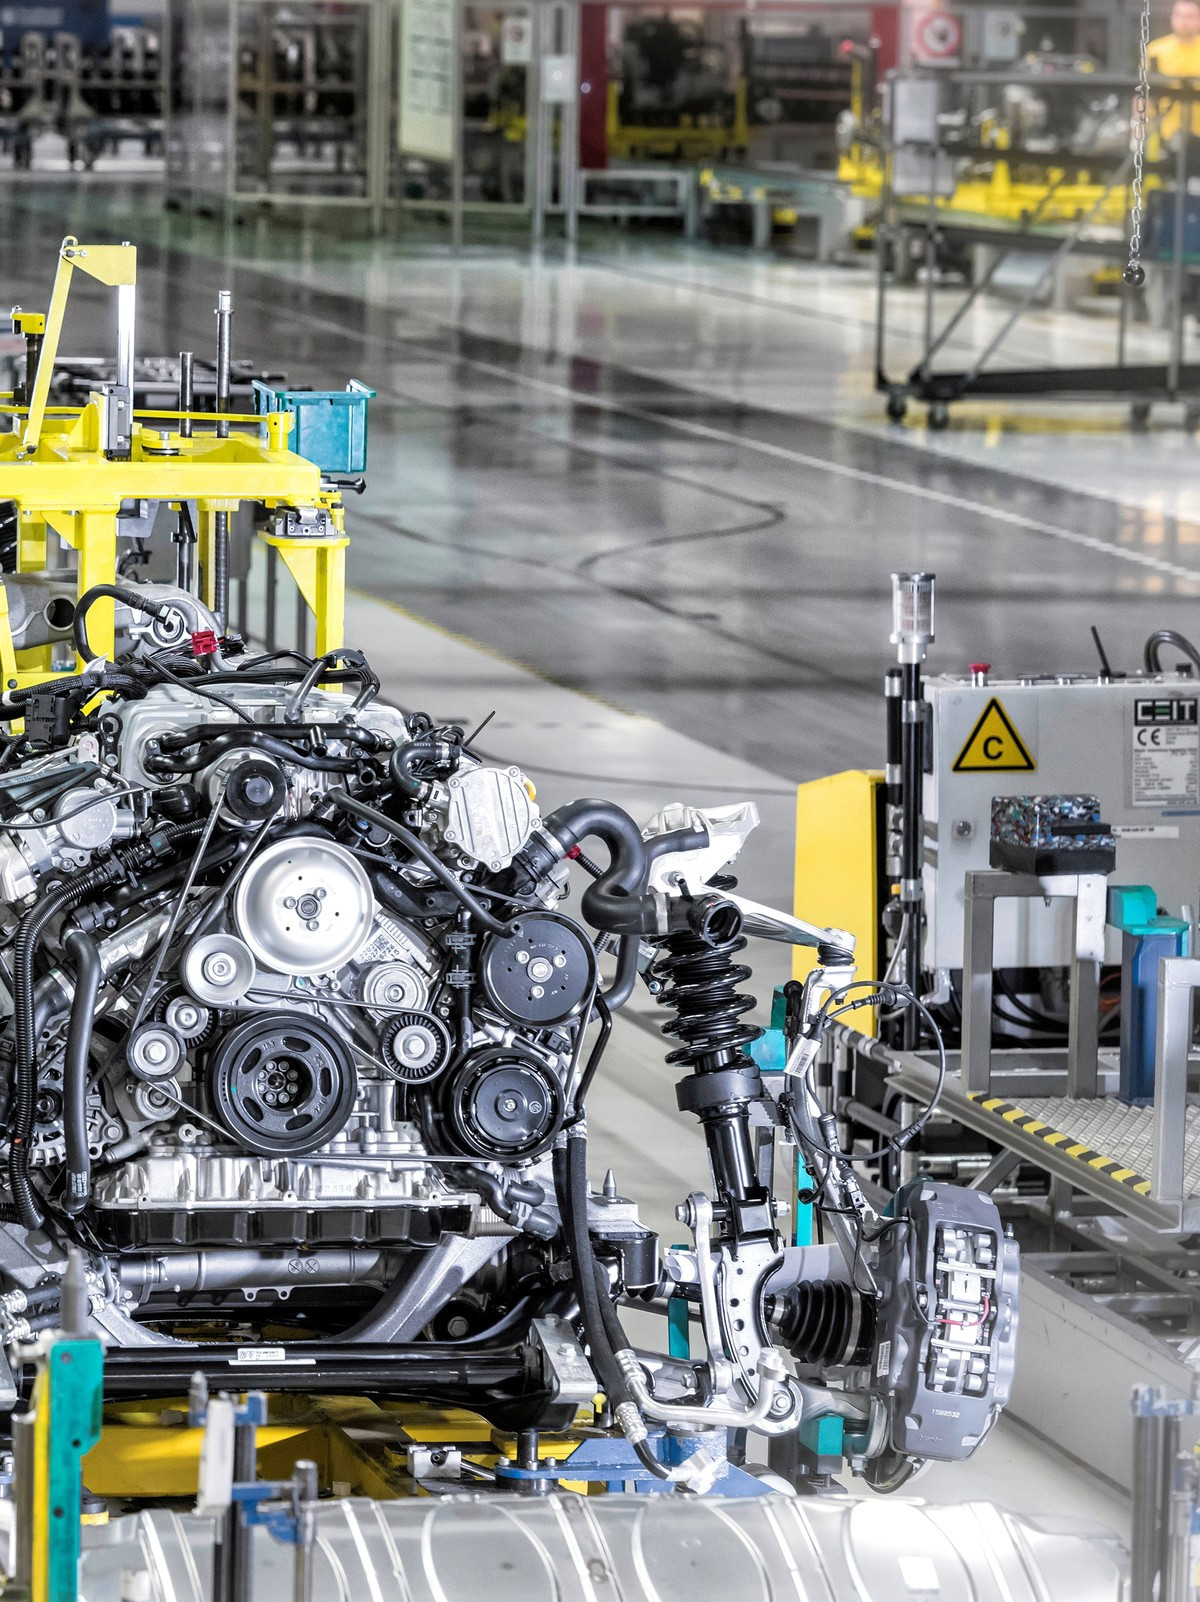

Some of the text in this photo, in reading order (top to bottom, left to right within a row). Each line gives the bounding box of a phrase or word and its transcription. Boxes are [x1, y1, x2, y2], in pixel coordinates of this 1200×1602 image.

[1137, 700, 1196, 720] CEIT
[1137, 728, 1161, 746] CE
[983, 736, 1004, 760] C
